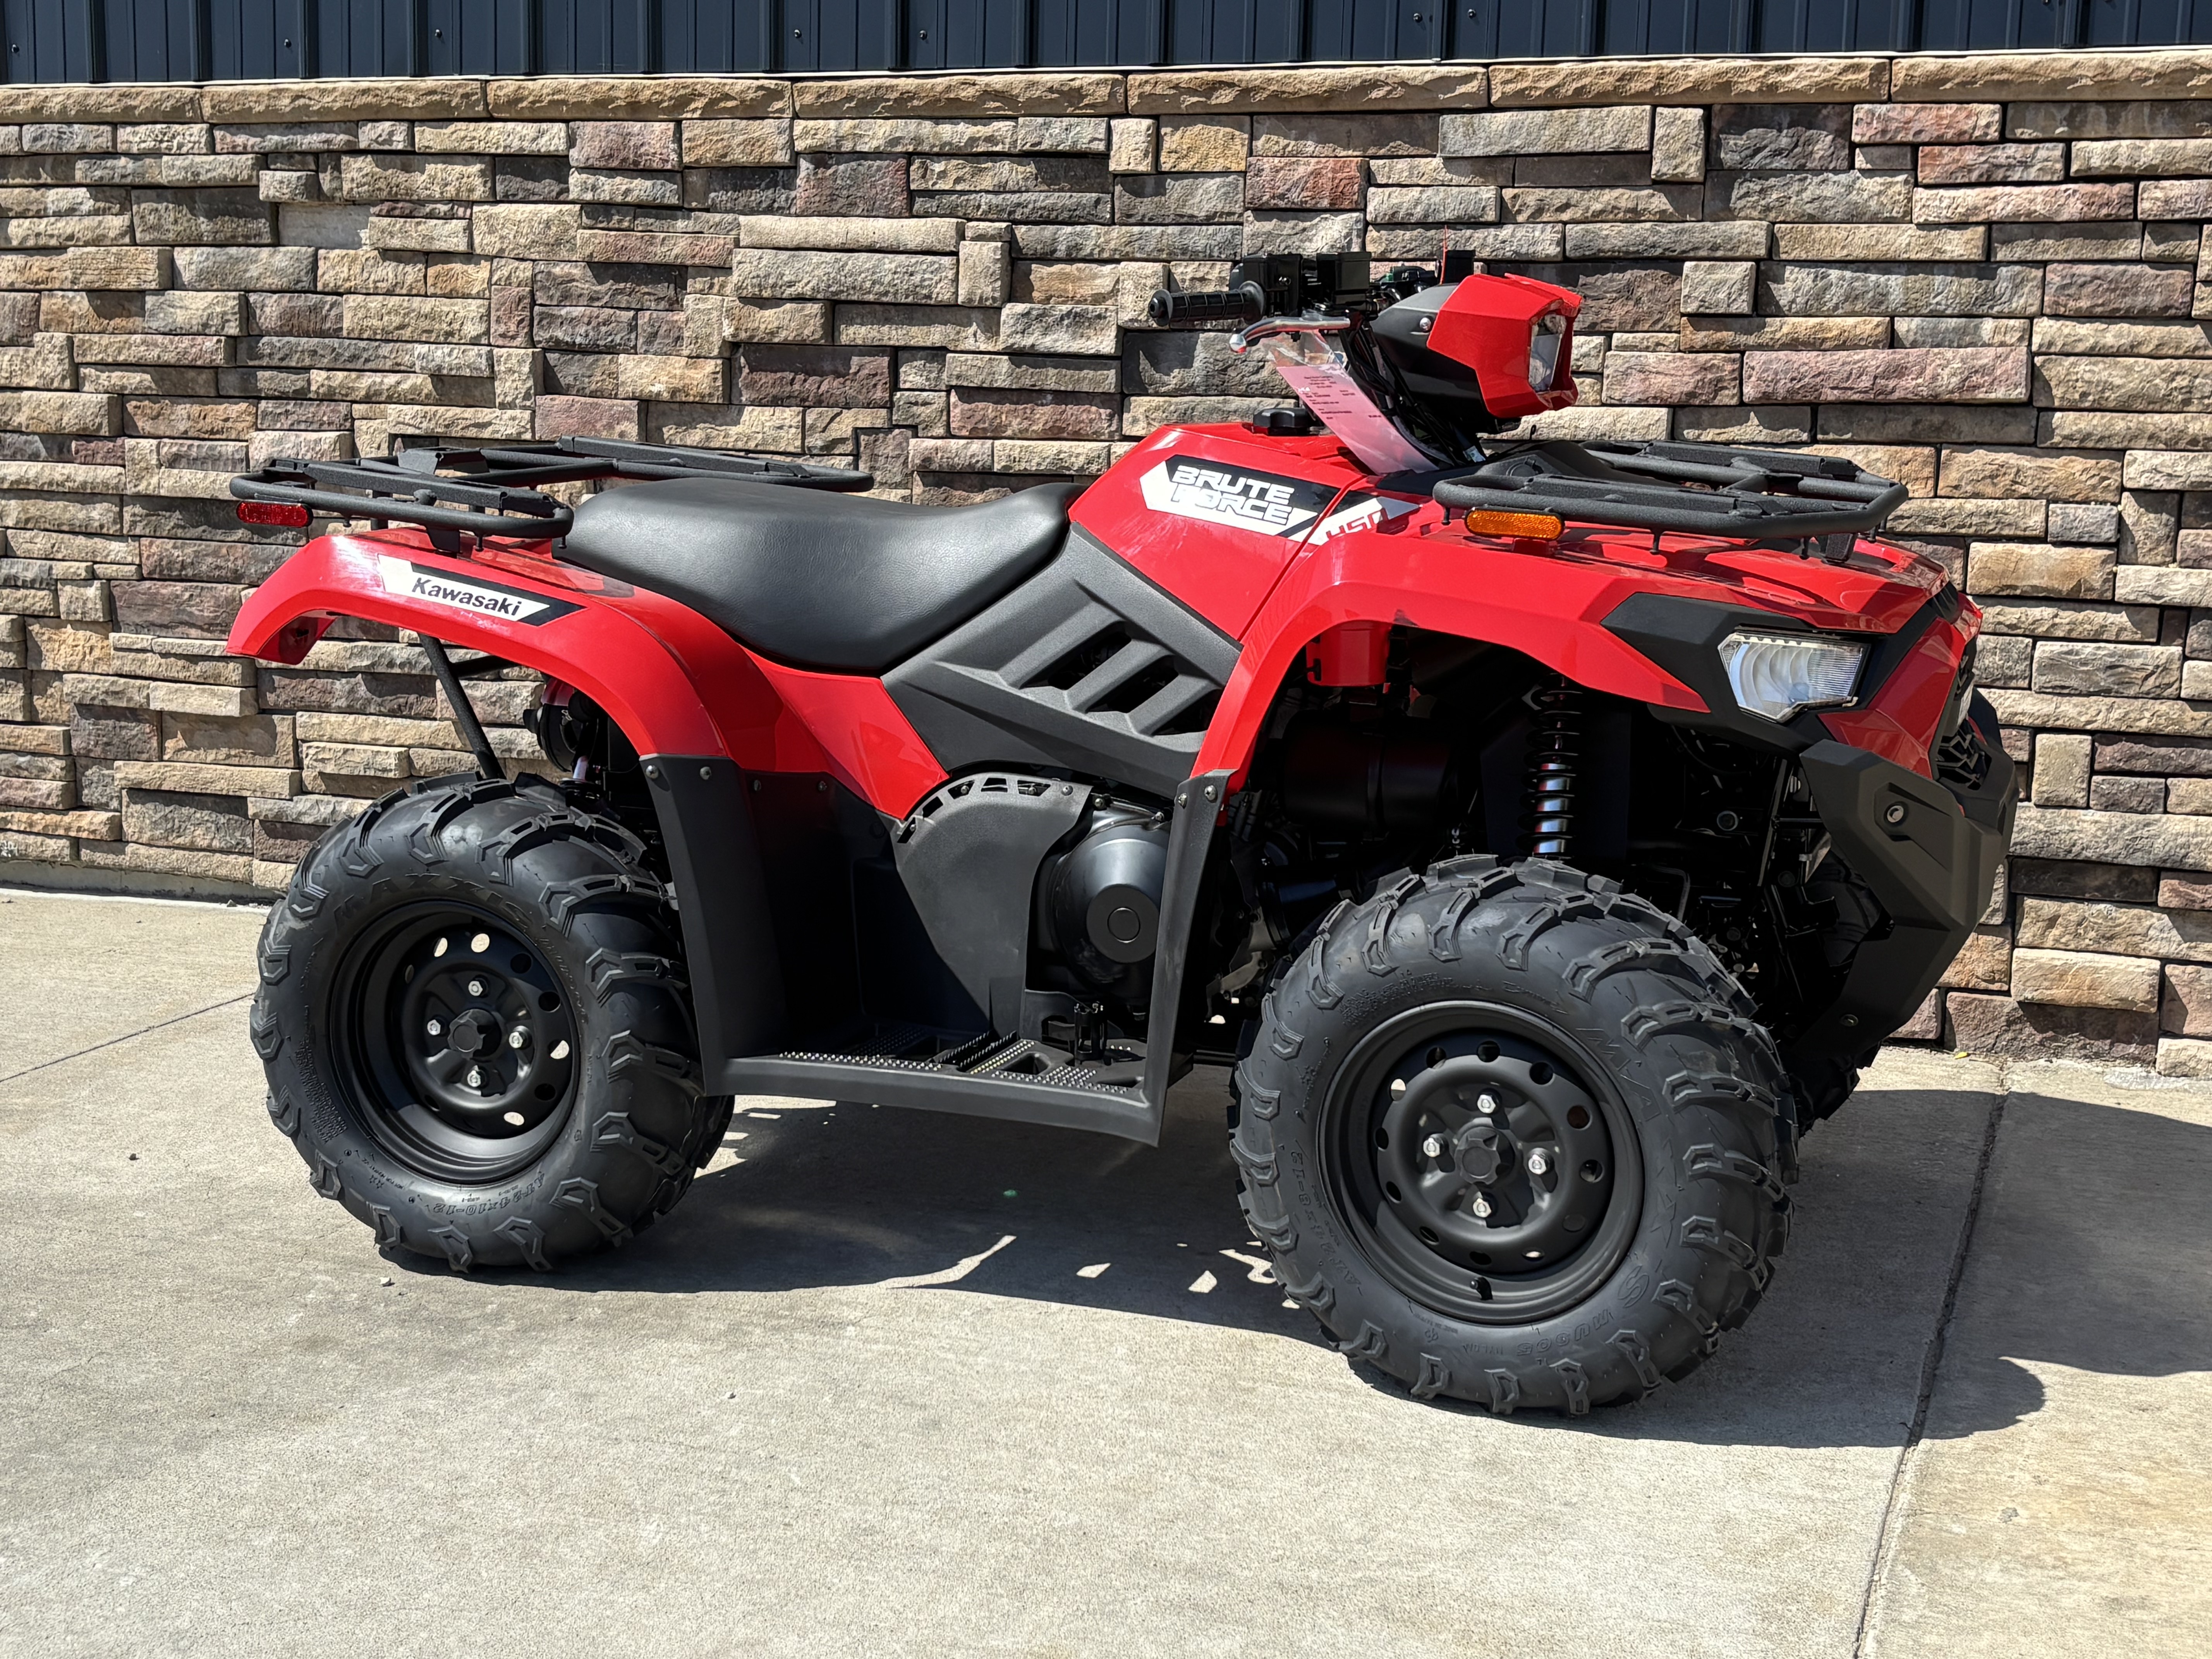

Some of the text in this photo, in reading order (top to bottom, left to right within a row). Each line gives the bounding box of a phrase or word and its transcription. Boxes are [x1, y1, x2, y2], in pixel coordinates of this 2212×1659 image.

[1171, 483, 1292, 526] FORCE
[1172, 465, 1295, 505] BRUTE
[412, 577, 521, 616] Kawasaki
